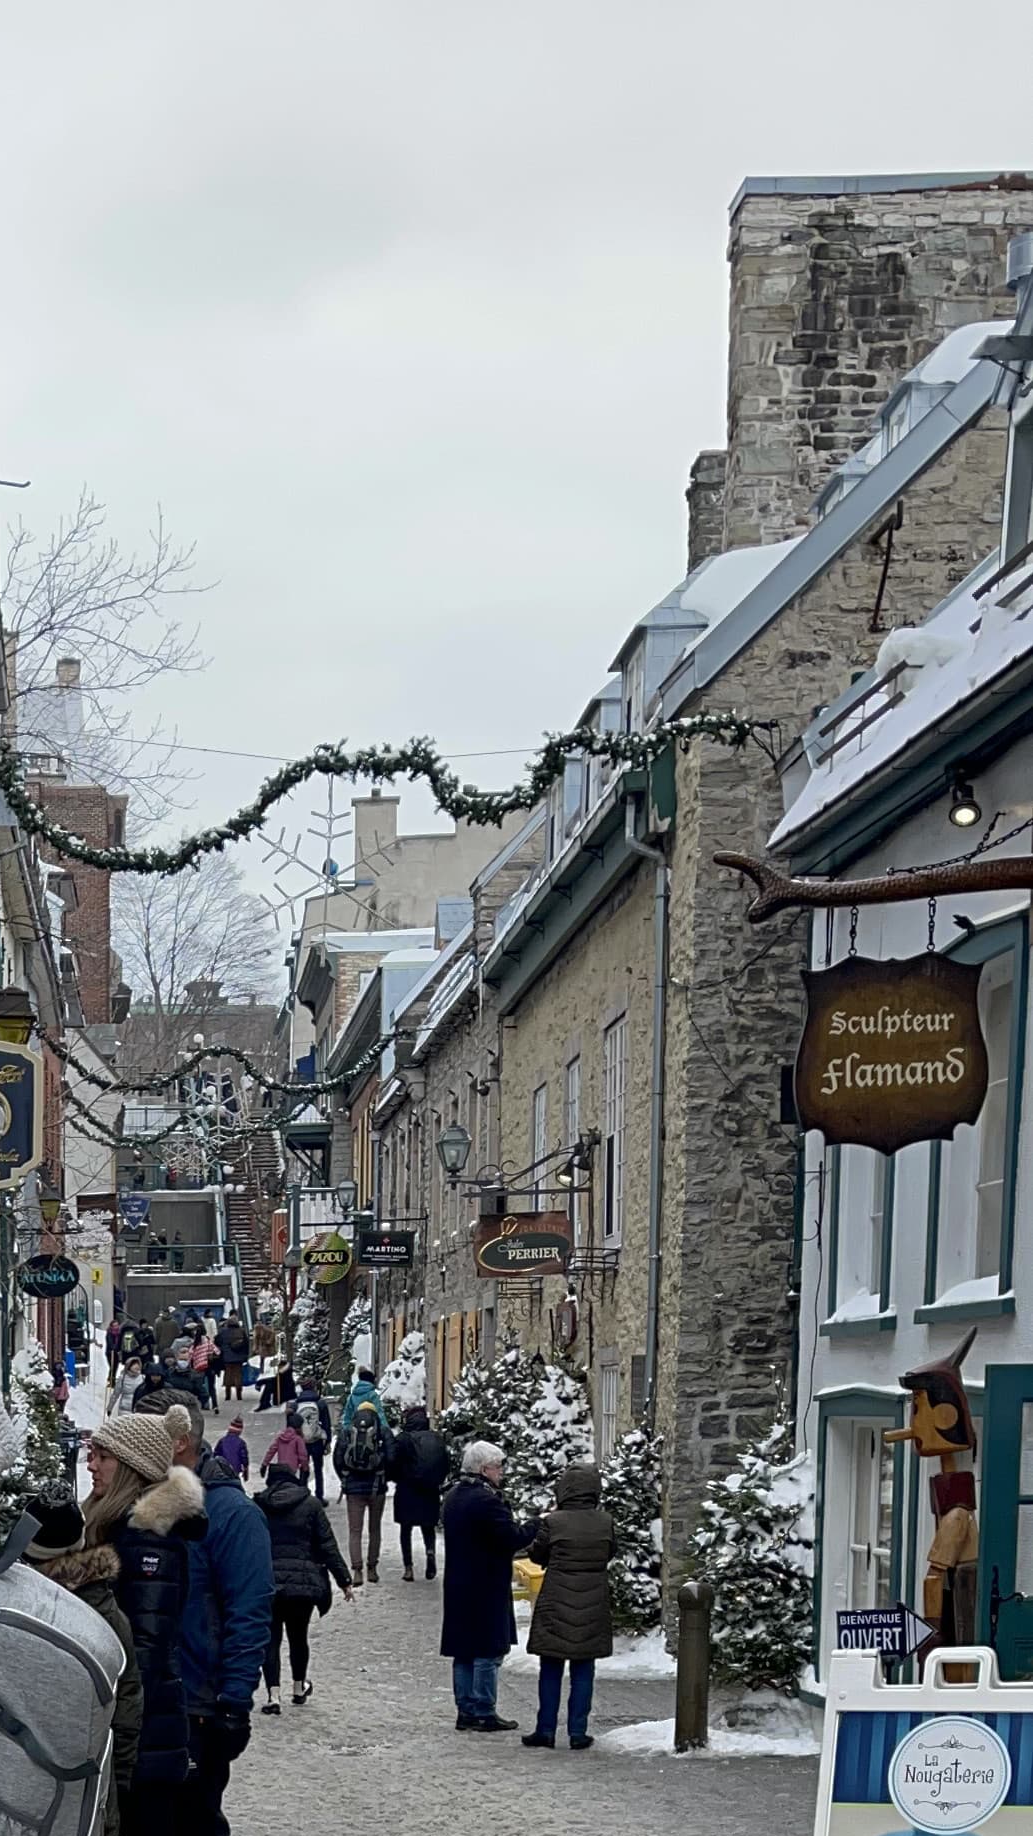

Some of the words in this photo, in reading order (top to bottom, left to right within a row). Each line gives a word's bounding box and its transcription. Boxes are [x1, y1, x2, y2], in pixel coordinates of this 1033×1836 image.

[829, 1006, 955, 1038] Sculpteur
[366, 1245, 407, 1253] MARTINO
[508, 1247, 561, 1263] PERRIER
[309, 1251, 343, 1263] ZAZOU
[839, 1613, 902, 1625] BIENVENUE
[840, 1627, 903, 1651] OUVERT
[924, 1753, 939, 1767] La
[904, 1758, 995, 1798] Nougaterie
